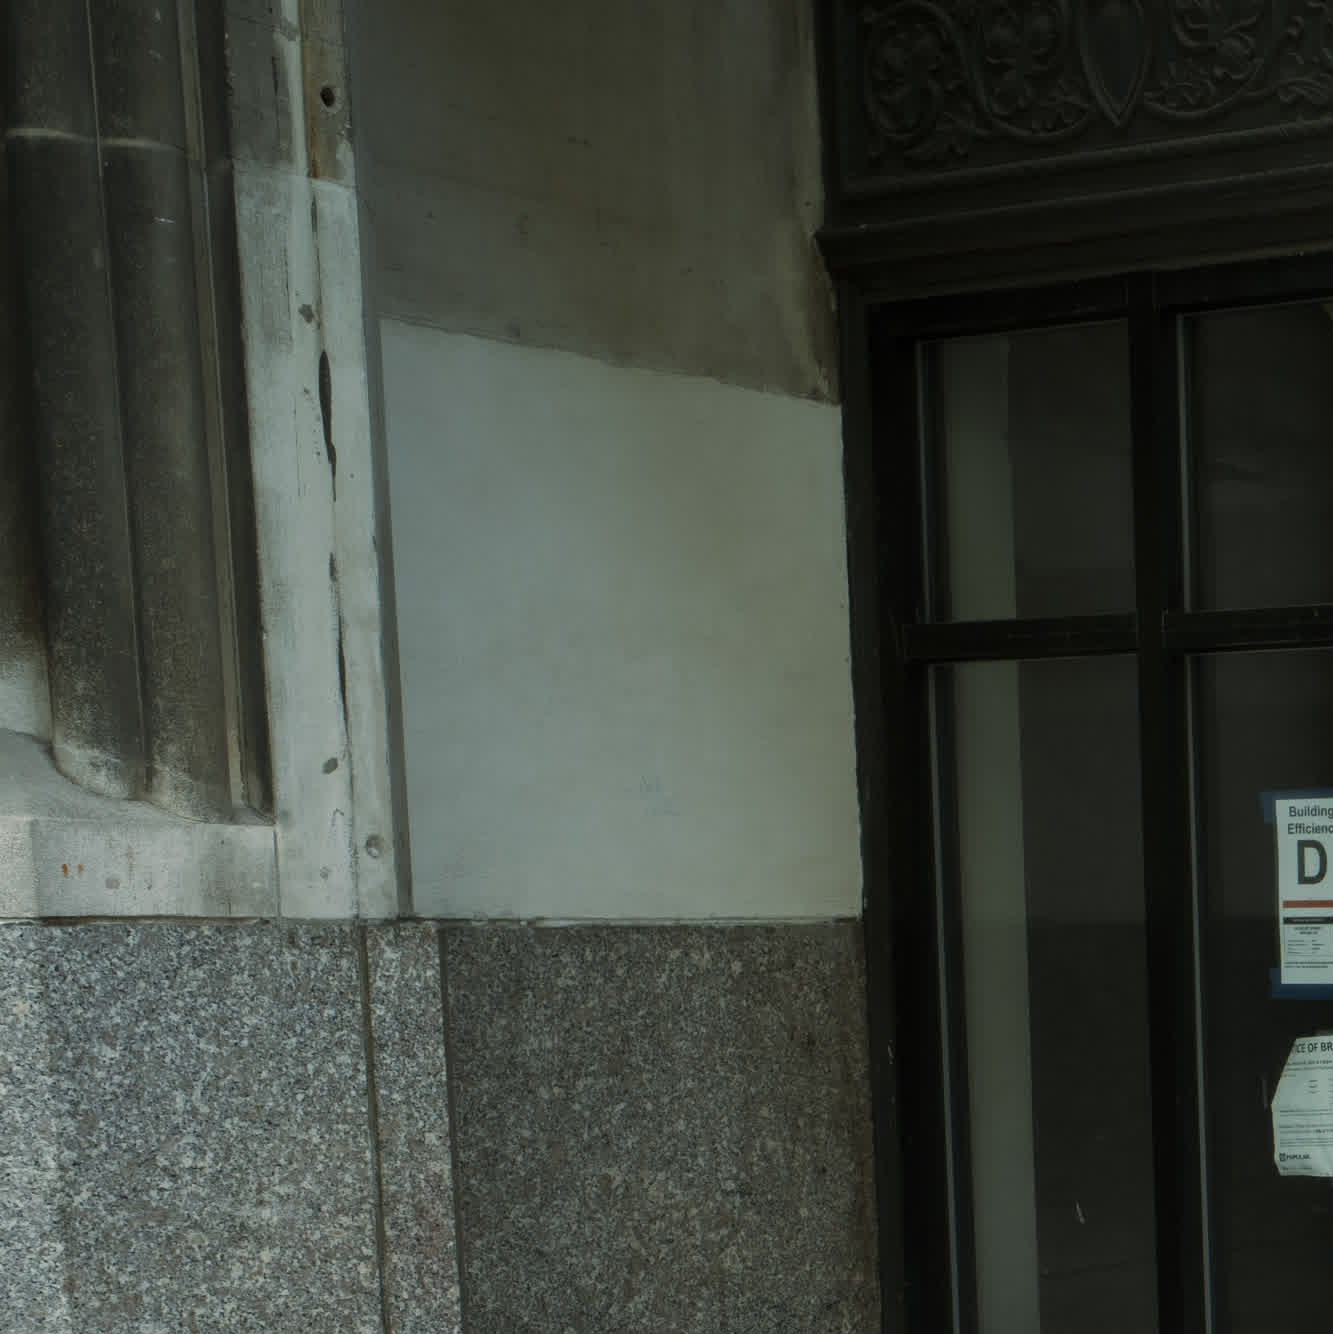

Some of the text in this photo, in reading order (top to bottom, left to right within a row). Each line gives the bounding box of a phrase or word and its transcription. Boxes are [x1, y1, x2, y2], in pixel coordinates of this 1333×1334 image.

[1288, 805, 1333, 819] Building
[1297, 839, 1328, 885] D
[1307, 1043, 1319, 1053] OF
